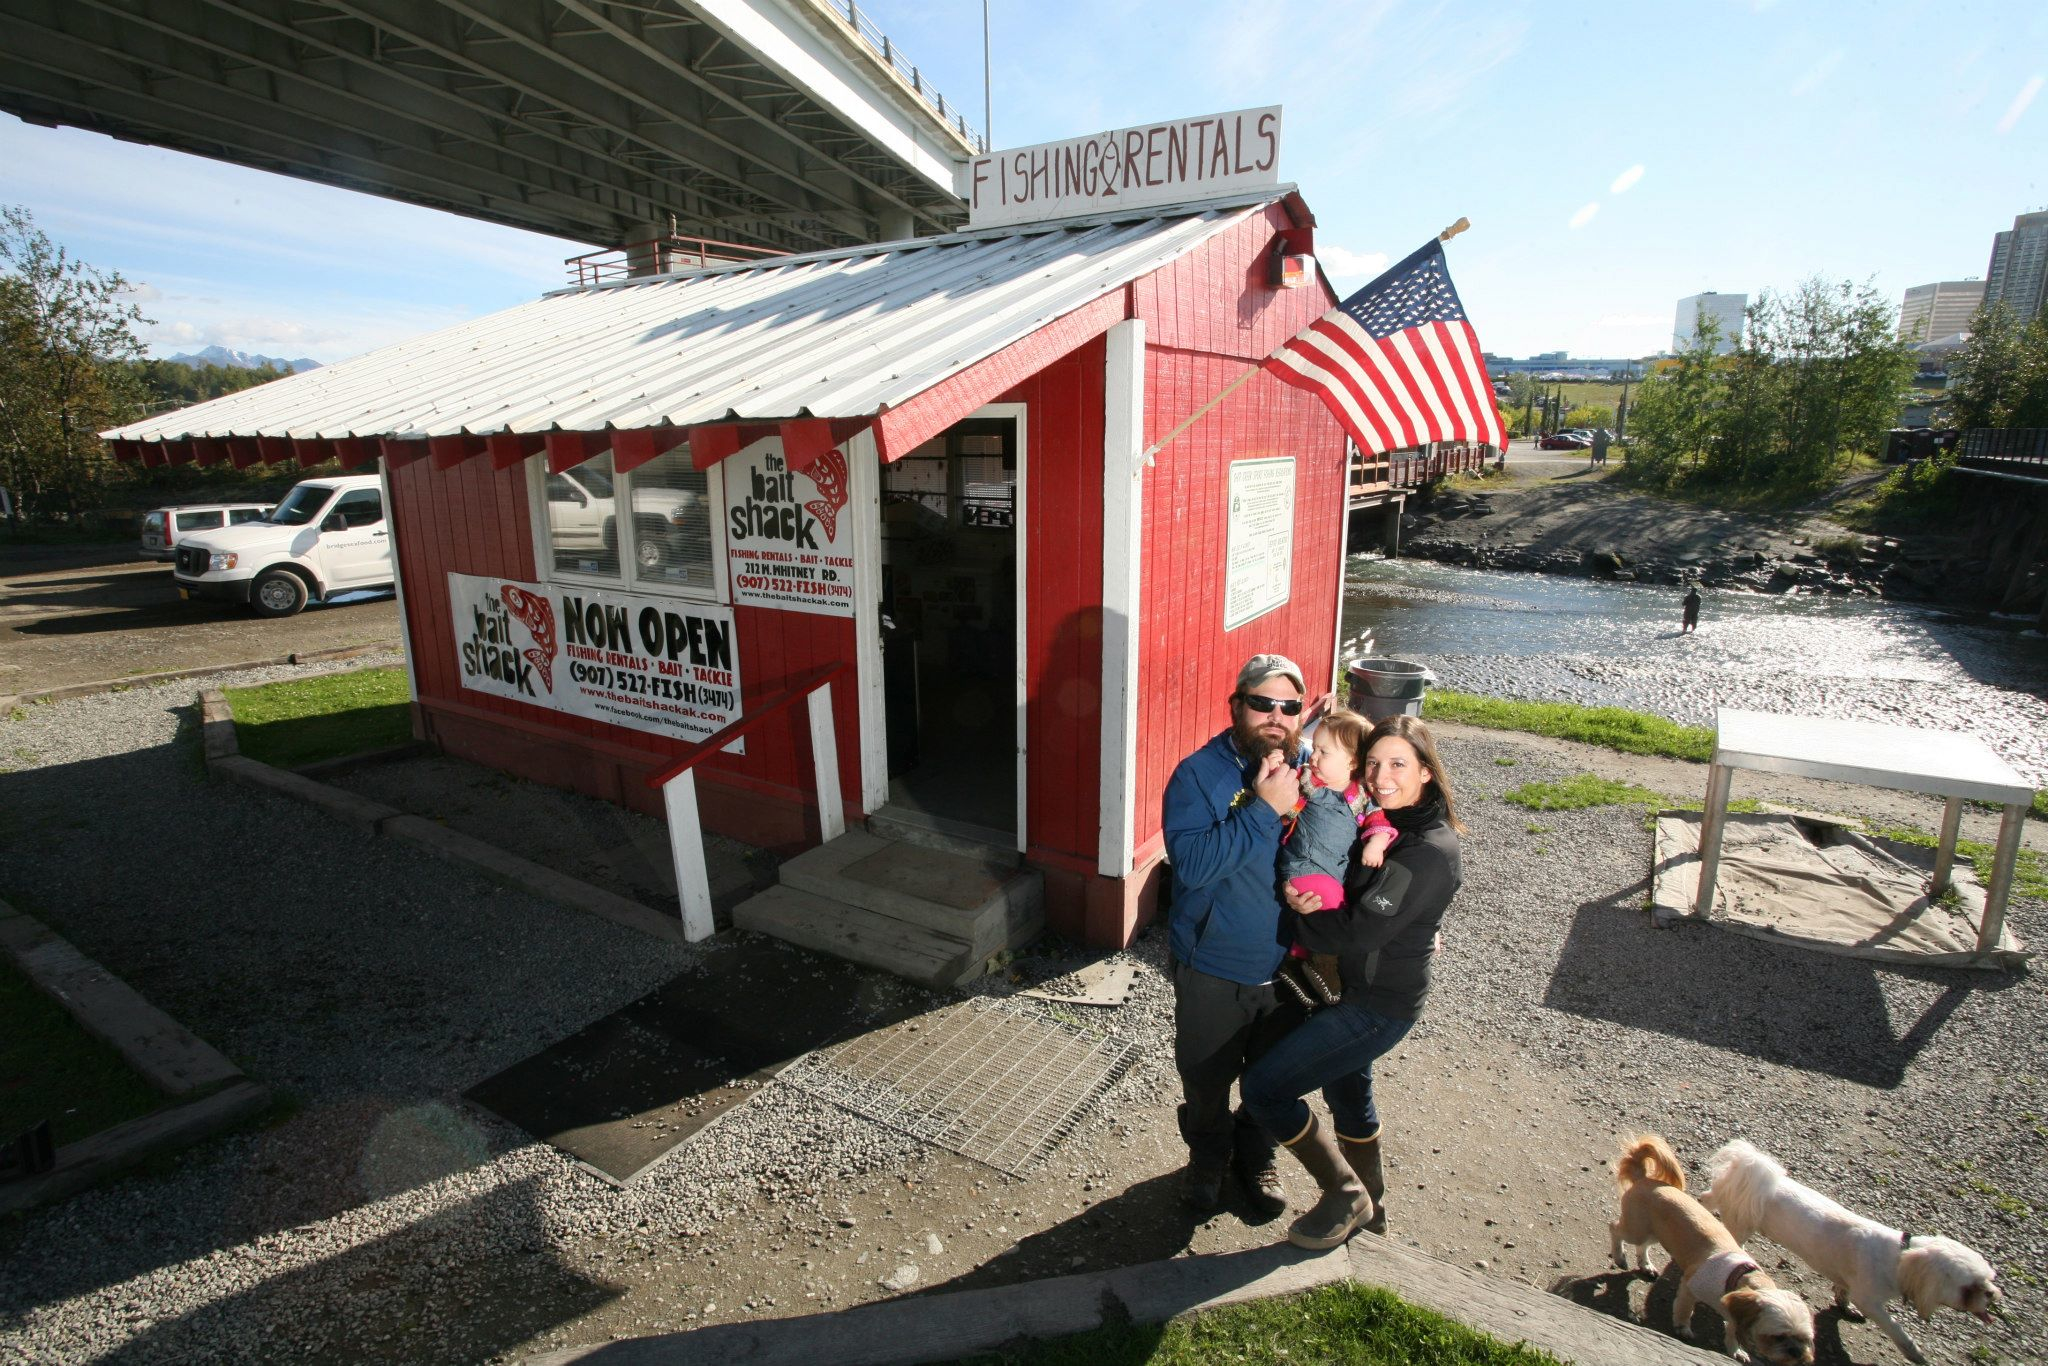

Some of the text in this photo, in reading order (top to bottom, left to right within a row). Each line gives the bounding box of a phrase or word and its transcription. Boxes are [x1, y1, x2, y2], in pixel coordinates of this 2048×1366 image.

[973, 113, 1277, 209] FISHING RENTALS
[765, 453, 784, 471] the
[750, 466, 795, 503] bait
[730, 496, 819, 550] shack
[730, 549, 854, 568] FISHING RENTALS BAIT TACKLE
[744, 562, 760, 575] 212
[822, 569, 841, 582] RD.
[485, 592, 501, 614] the
[736, 574, 770, 591] (907)
[827, 583, 852, 599] (3474)
[741, 590, 849, 608] www.thebaitshackak.com
[473, 604, 513, 646] bait
[562, 596, 733, 672] NOW OPEN
[462, 633, 537, 698] shack
[566, 644, 733, 687] FISHING RENTALS BAIT TACKLE
[569, 660, 614, 689] (907)
[697, 685, 735, 712] (3474)
[579, 686, 727, 724] www.thebaitshackak.com
[594, 702, 714, 735] www.facebook.com/thebaitshack
